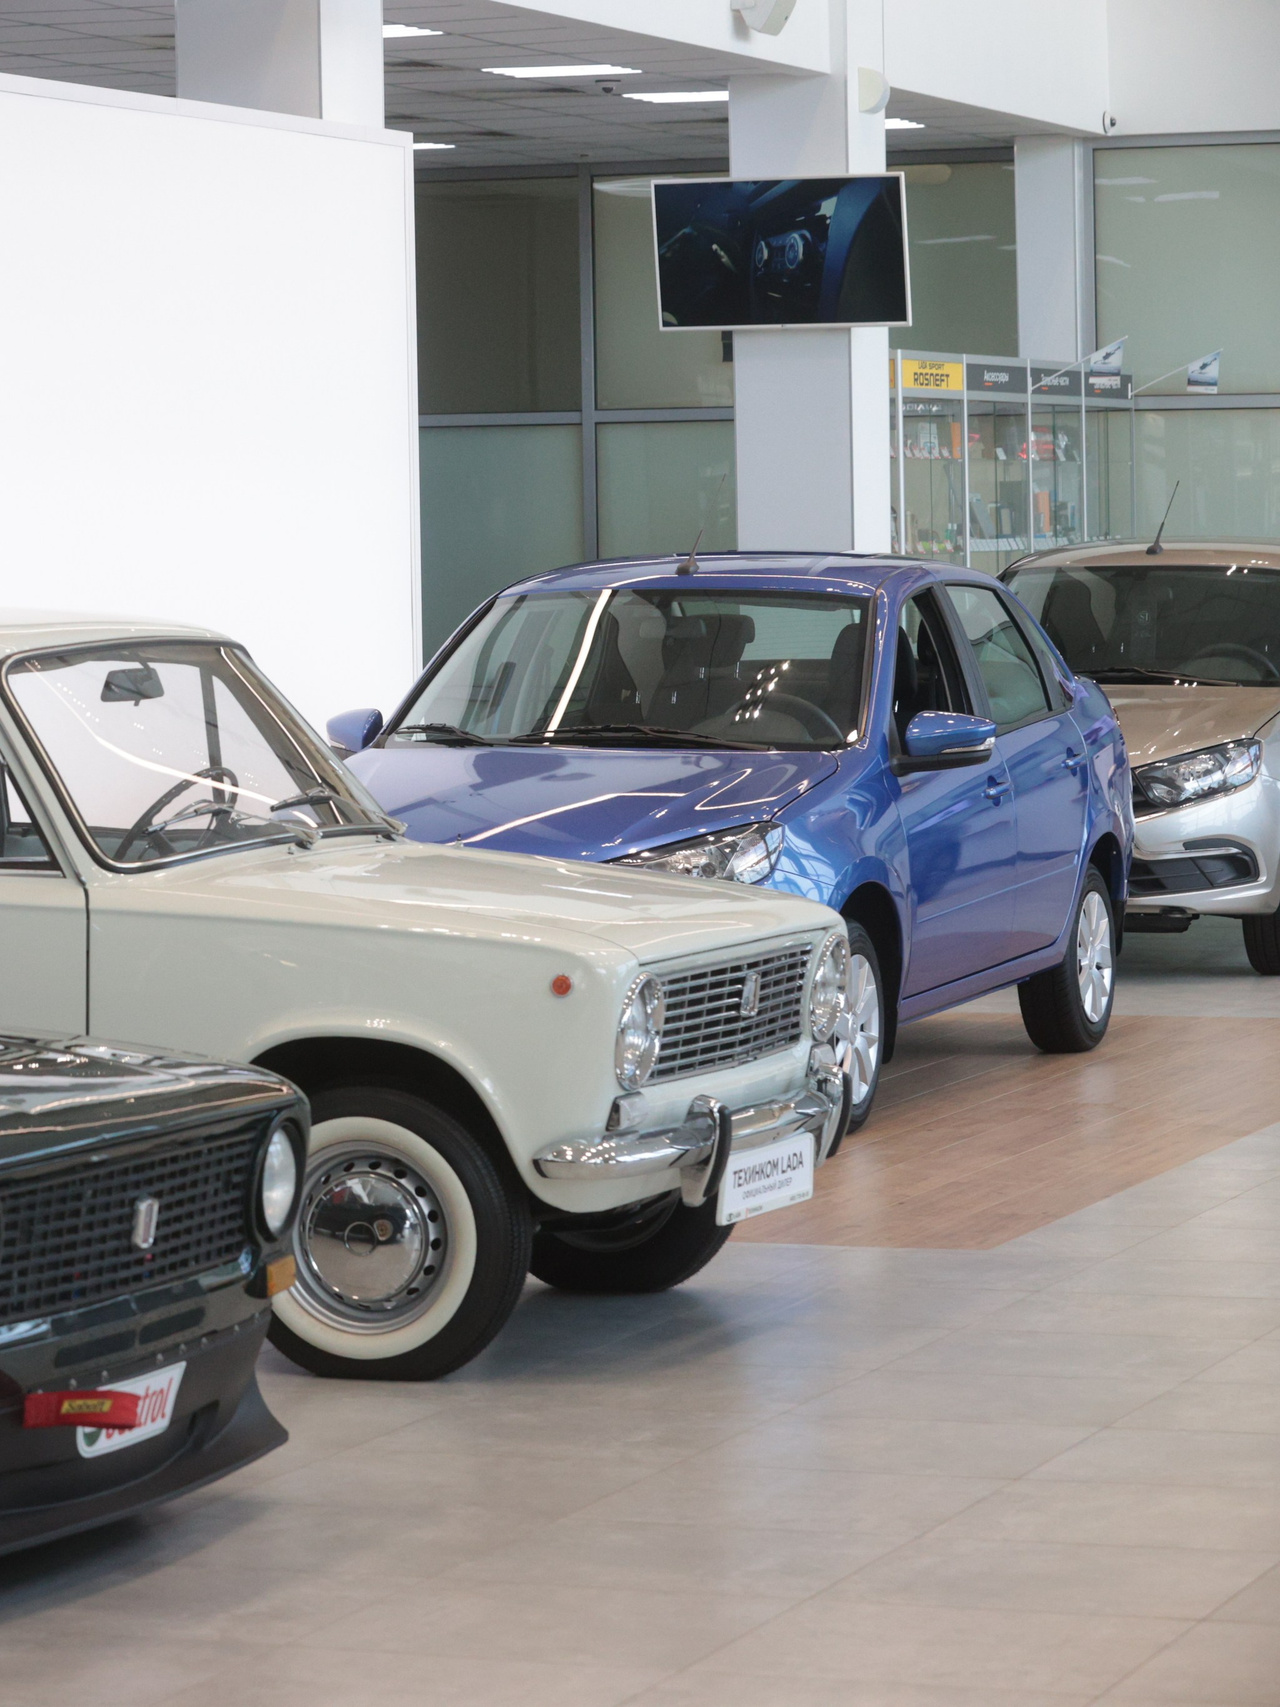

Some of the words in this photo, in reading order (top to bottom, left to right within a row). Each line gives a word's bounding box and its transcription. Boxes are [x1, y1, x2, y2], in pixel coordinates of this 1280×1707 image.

[913, 372, 950, 388] ROSNEFT
[732, 1156, 780, 1190] ТЕХИНКОМ
[781, 1150, 805, 1175] LADA
